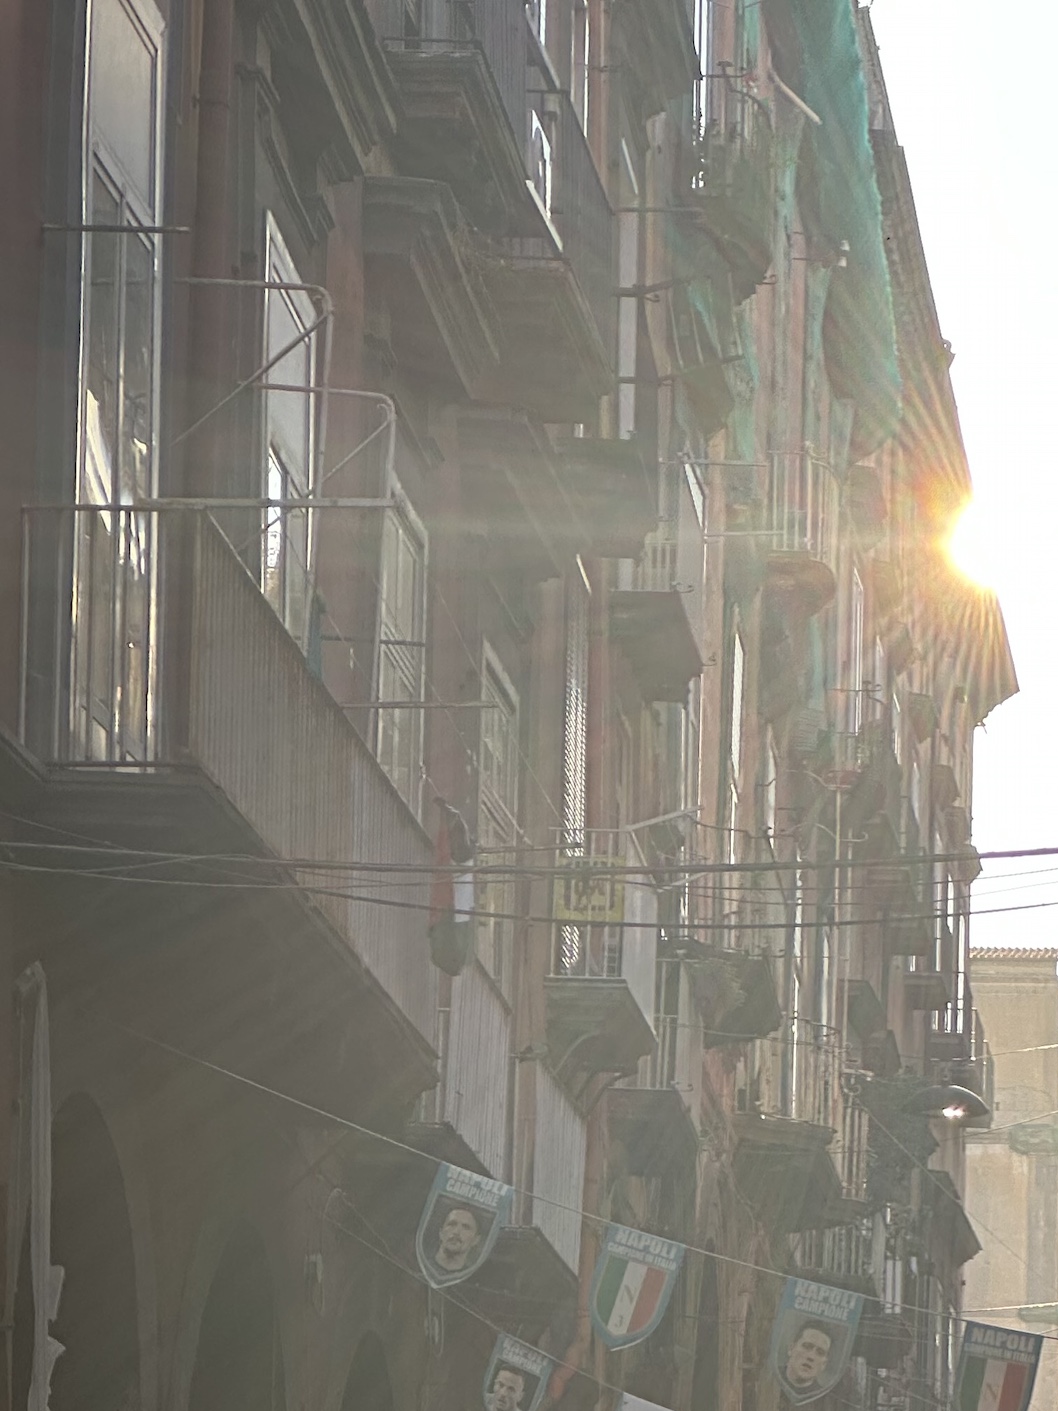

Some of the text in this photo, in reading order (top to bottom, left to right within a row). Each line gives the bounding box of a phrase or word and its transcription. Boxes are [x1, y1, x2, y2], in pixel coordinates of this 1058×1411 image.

[446, 1178, 501, 1207] CAMPIONE
[448, 1165, 508, 1197] NAPOLI
[615, 1229, 678, 1260] NAPOLI
[794, 1296, 849, 1321] CAMPIONE
[795, 1279, 859, 1310] NAPOLI
[971, 1327, 1036, 1353] NAPOLI
